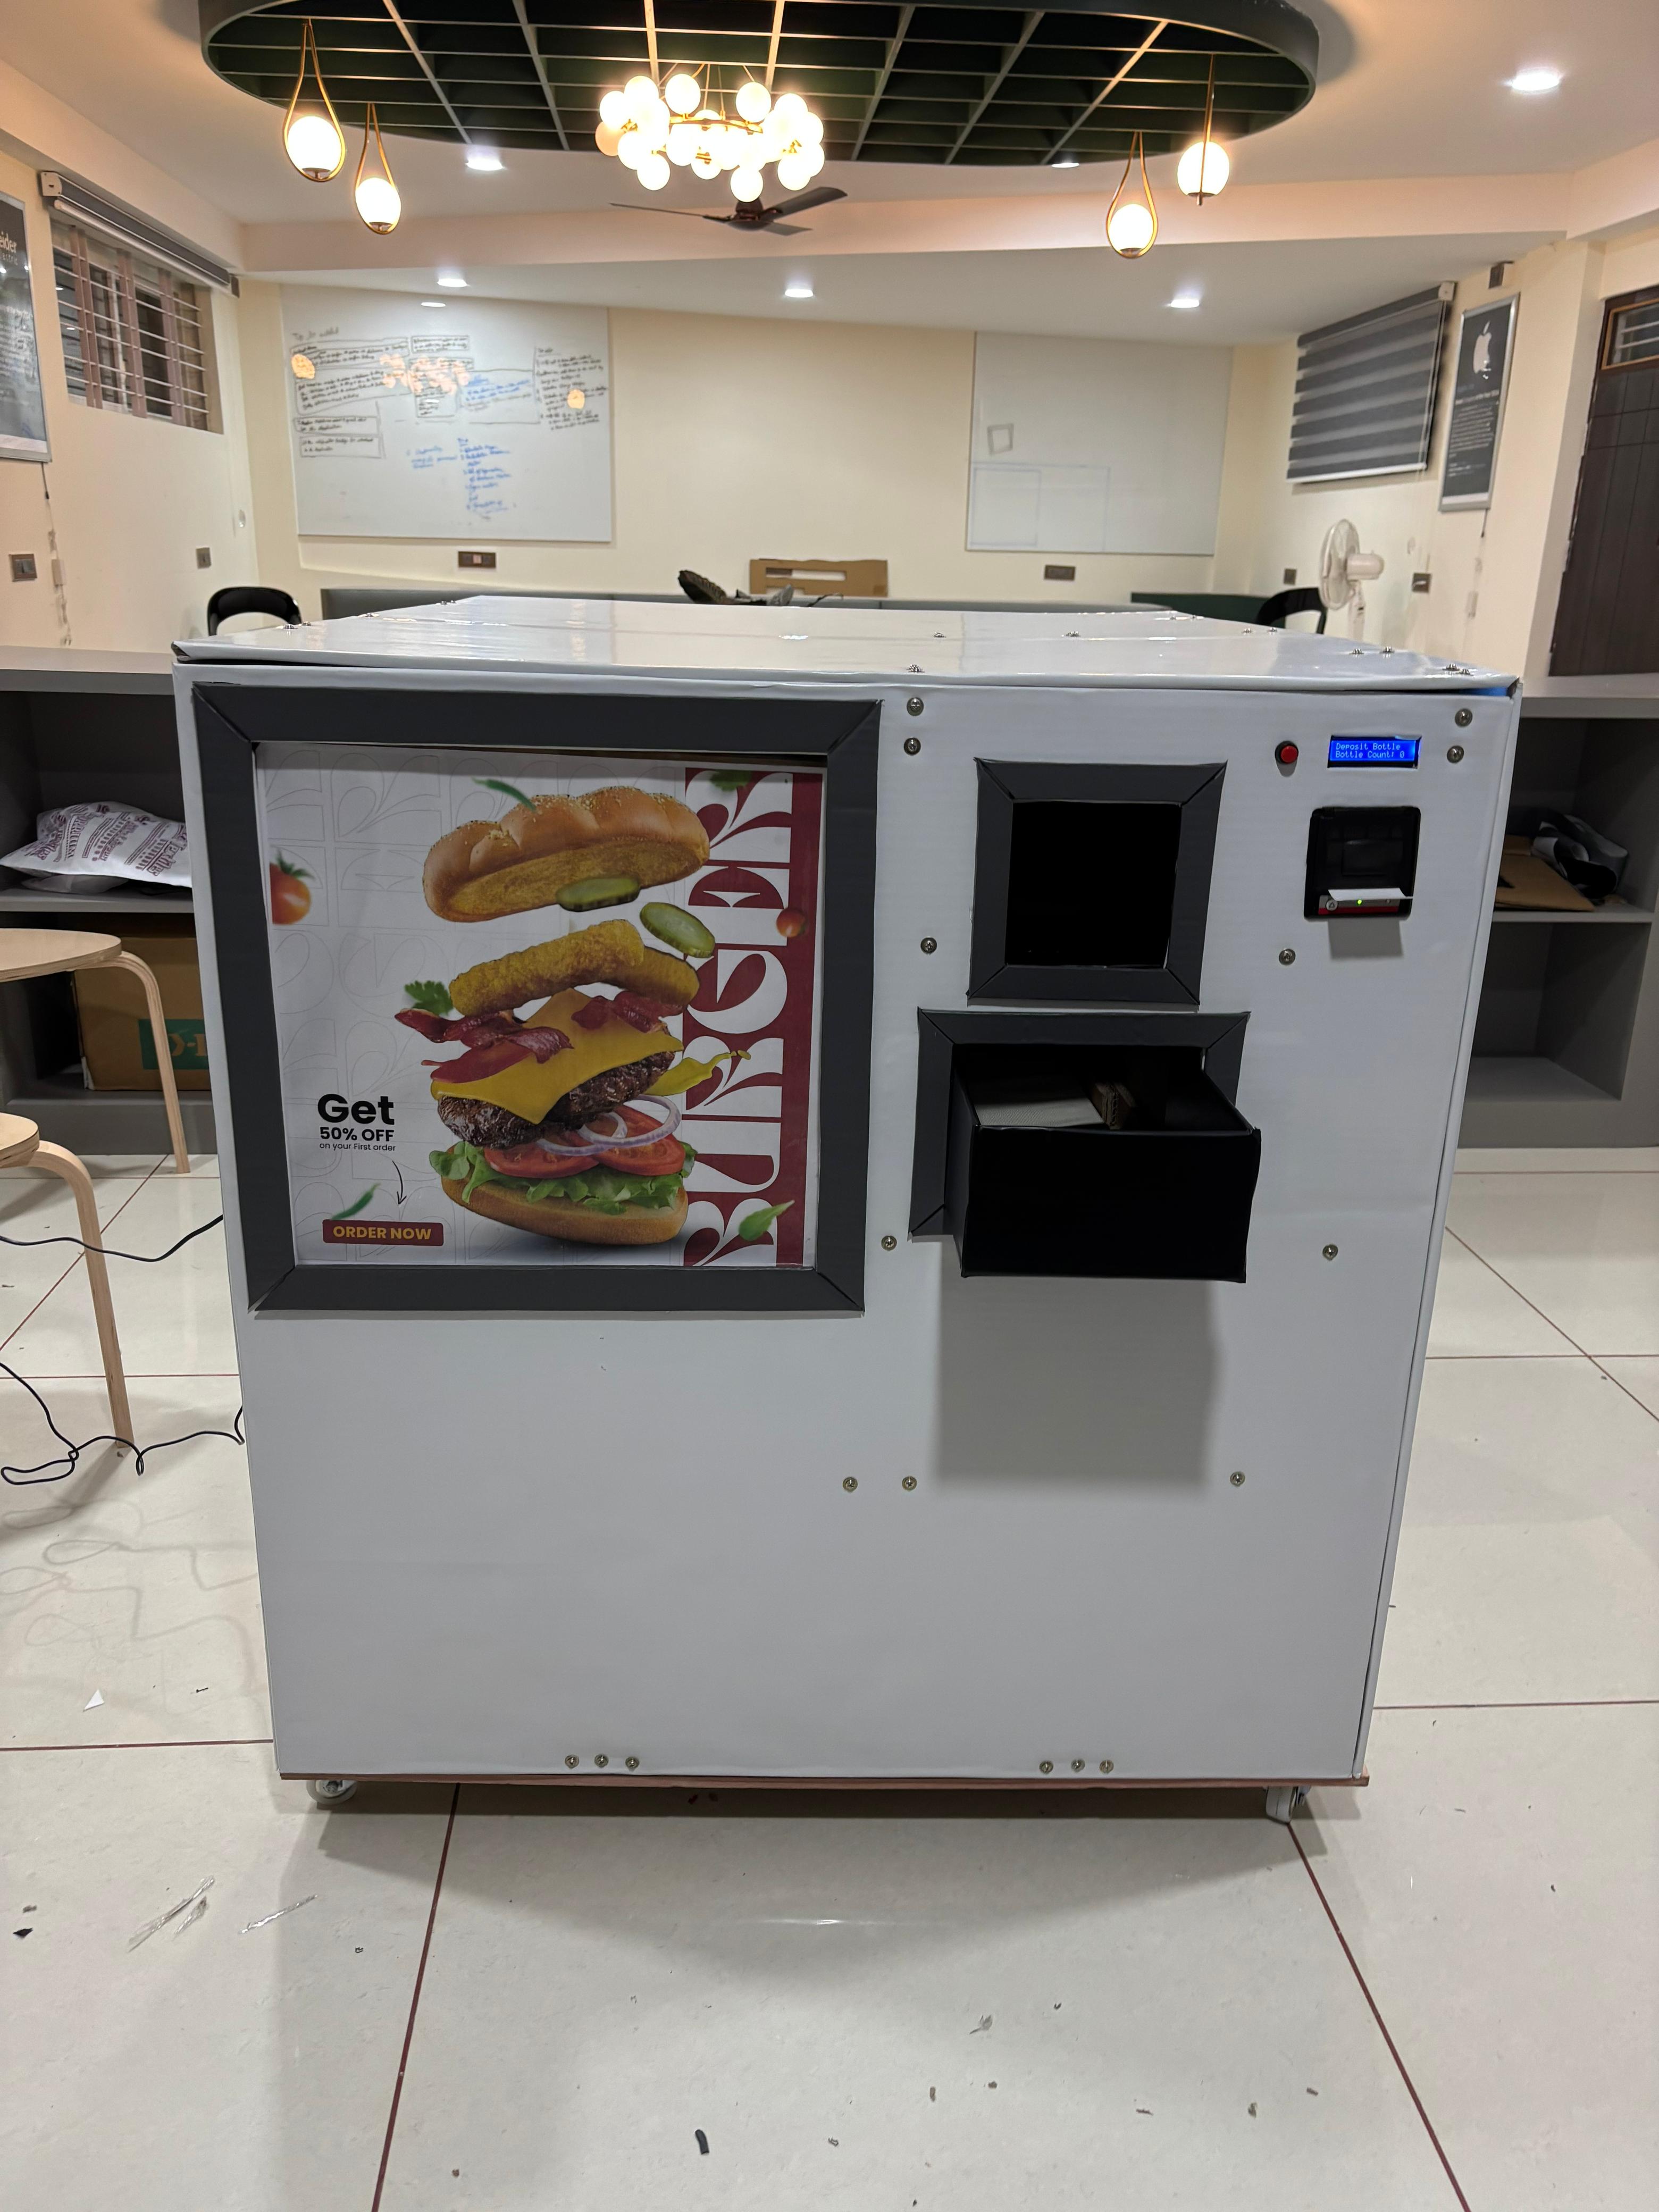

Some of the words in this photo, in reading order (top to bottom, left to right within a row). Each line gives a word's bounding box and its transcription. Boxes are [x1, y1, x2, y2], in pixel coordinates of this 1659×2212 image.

[684, 769, 793, 1267] BURGER
[317, 1094, 395, 1125] Get
[320, 1127, 357, 1141] 50%
[362, 1128, 395, 1142] OFF
[333, 1226, 387, 1239] ORDER
[390, 1227, 432, 1240] NOW
